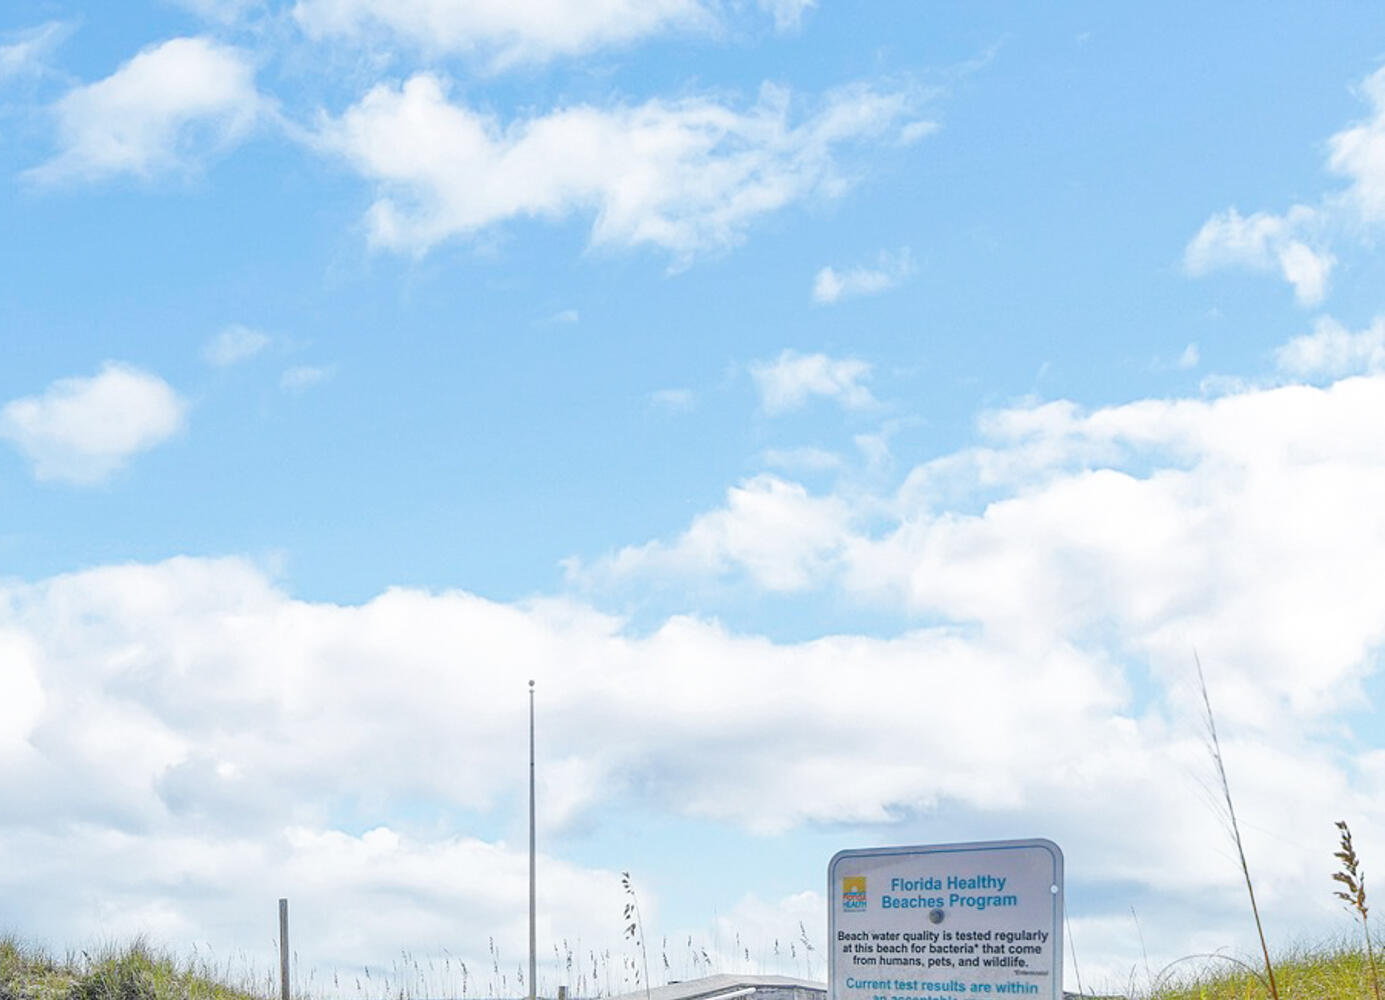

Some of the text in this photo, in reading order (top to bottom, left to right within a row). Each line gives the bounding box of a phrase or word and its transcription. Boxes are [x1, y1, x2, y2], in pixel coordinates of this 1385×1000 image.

[891, 875, 1007, 892] Florida Healthy
[882, 894, 1018, 910] Beaches Program
[838, 930, 1049, 944] Beach water quality is tested regularly
[843, 943, 852, 953] at
[855, 943, 874, 953] this
[876, 943, 908, 954] beach
[911, 943, 927, 954] for
[982, 944, 1006, 954] that
[1008, 946, 1042, 955] come
[853, 955, 1029, 969] from humans, pets, and wildlife.
[846, 978, 1039, 994] Current test results are within
